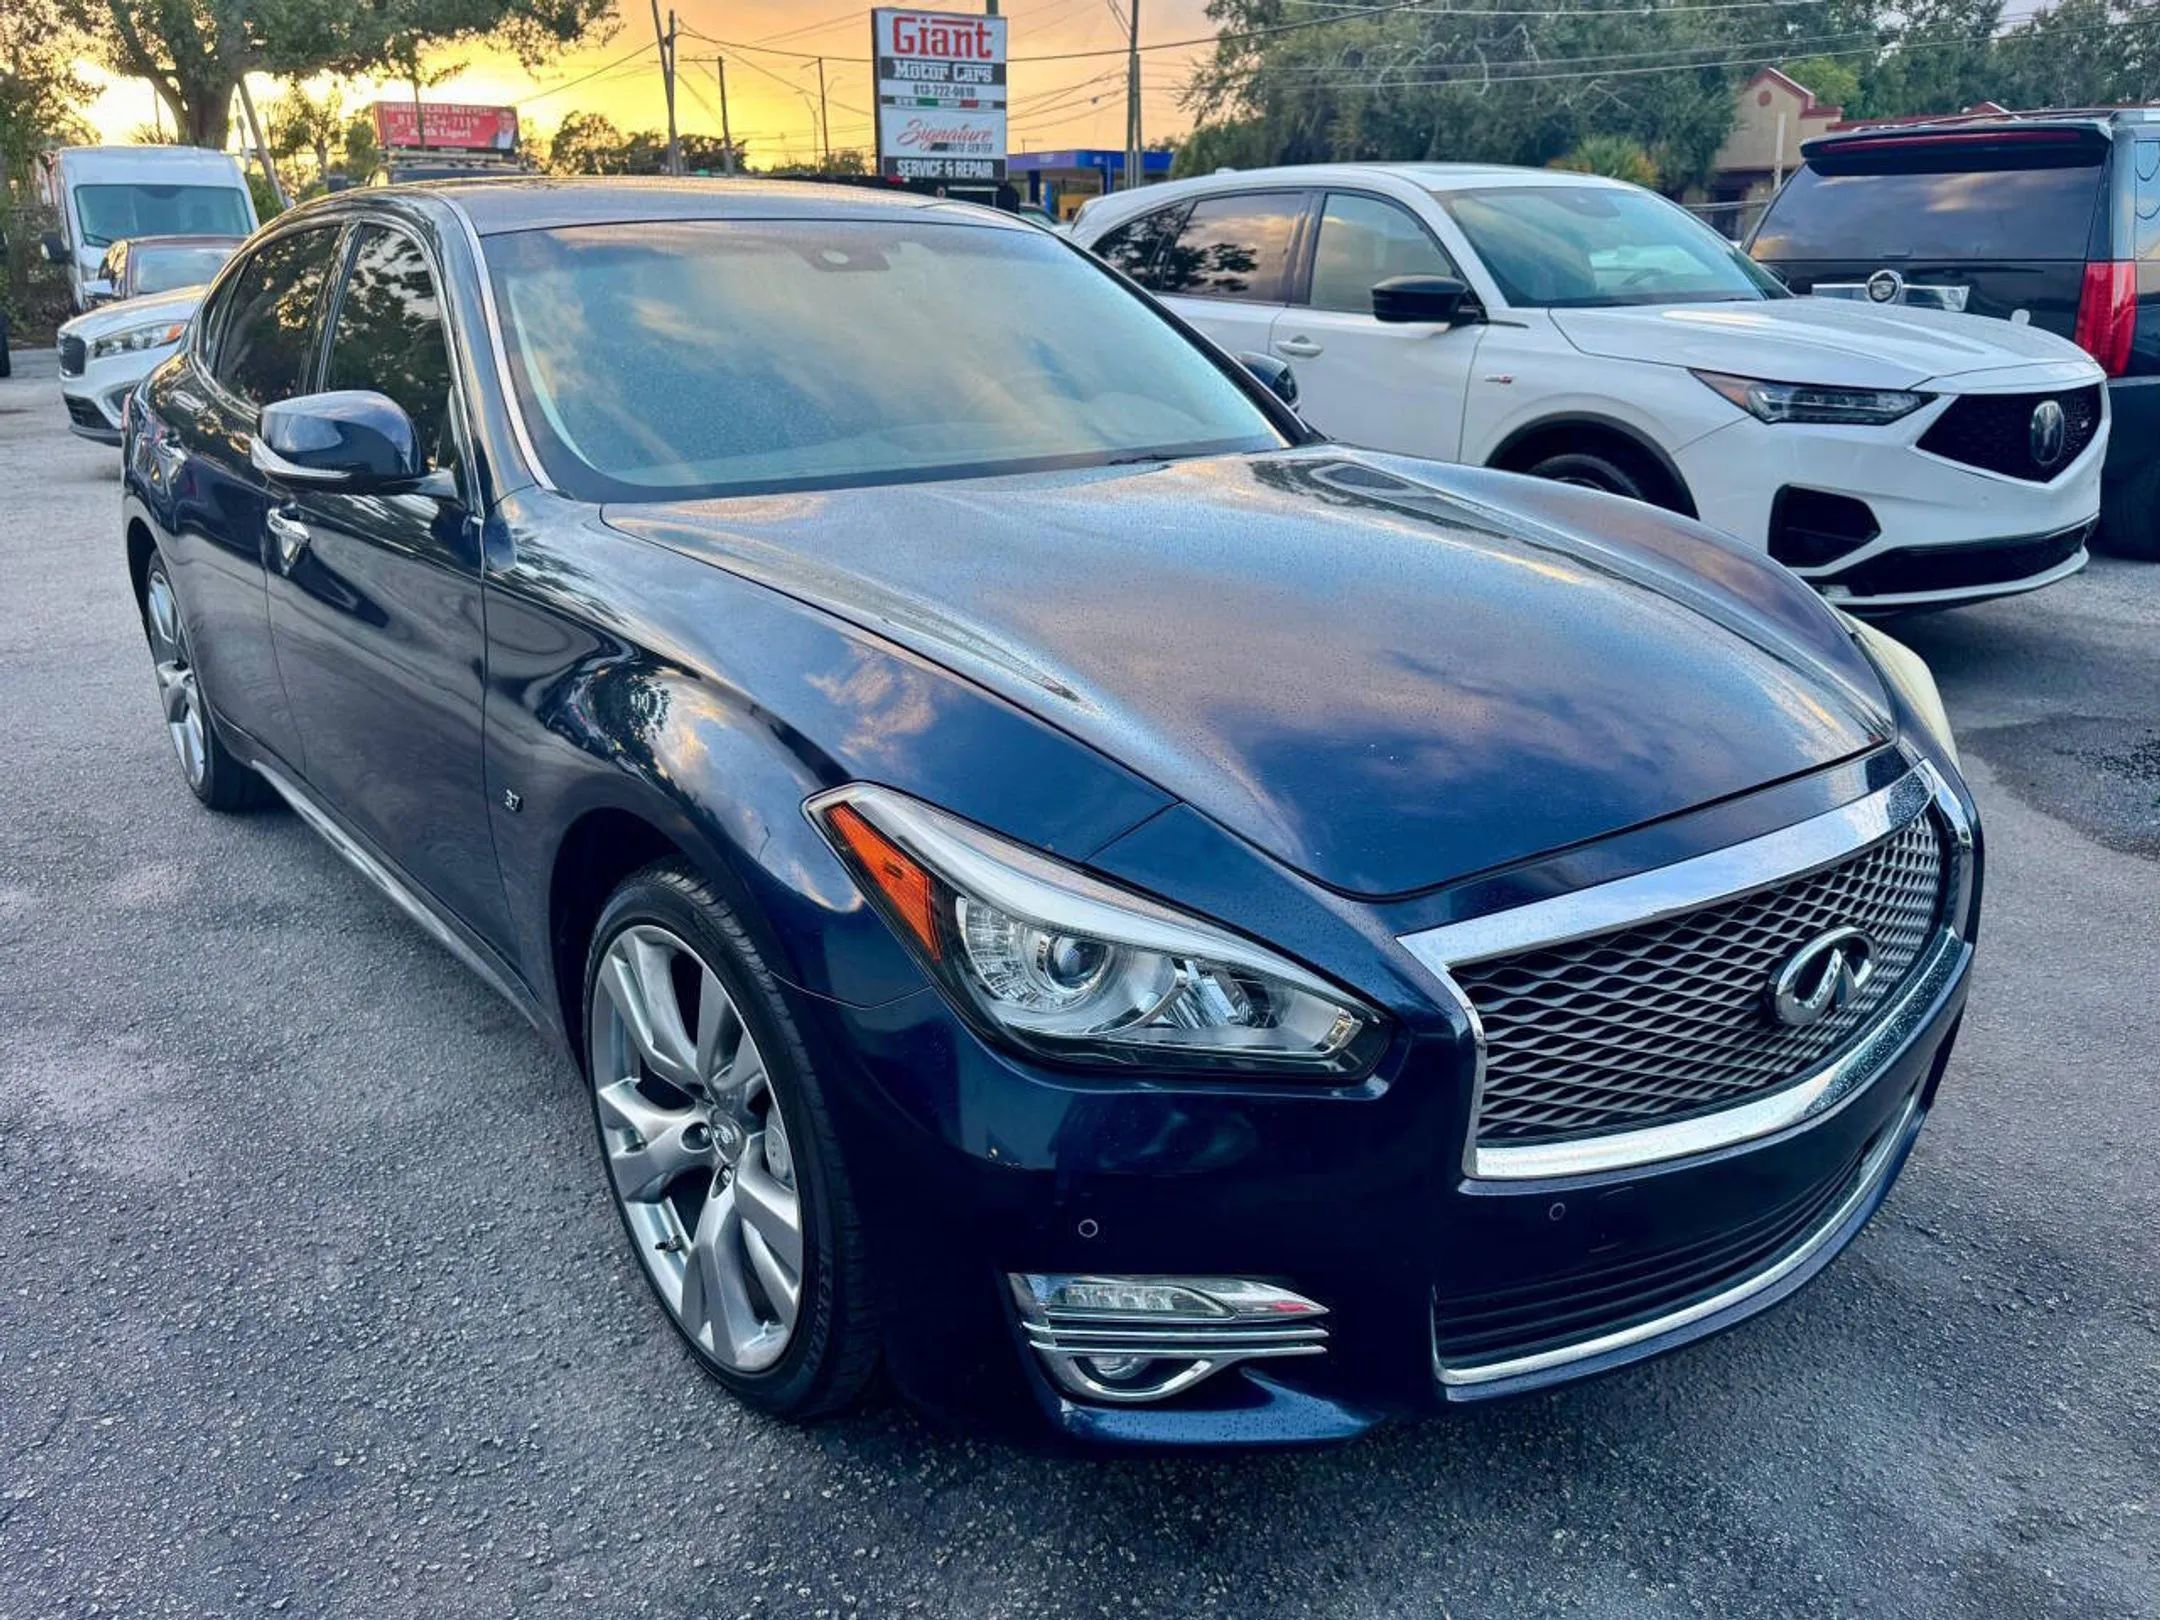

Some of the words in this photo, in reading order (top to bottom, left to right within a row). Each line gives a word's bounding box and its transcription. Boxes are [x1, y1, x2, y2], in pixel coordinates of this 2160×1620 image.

[892, 17, 993, 59] Giant
[894, 60, 949, 80] Motor
[953, 64, 993, 82] Cars
[896, 119, 993, 152] Signature
[896, 159, 943, 177] SERVICE
[944, 161, 954, 178] &
[954, 161, 994, 179] REPAIR
